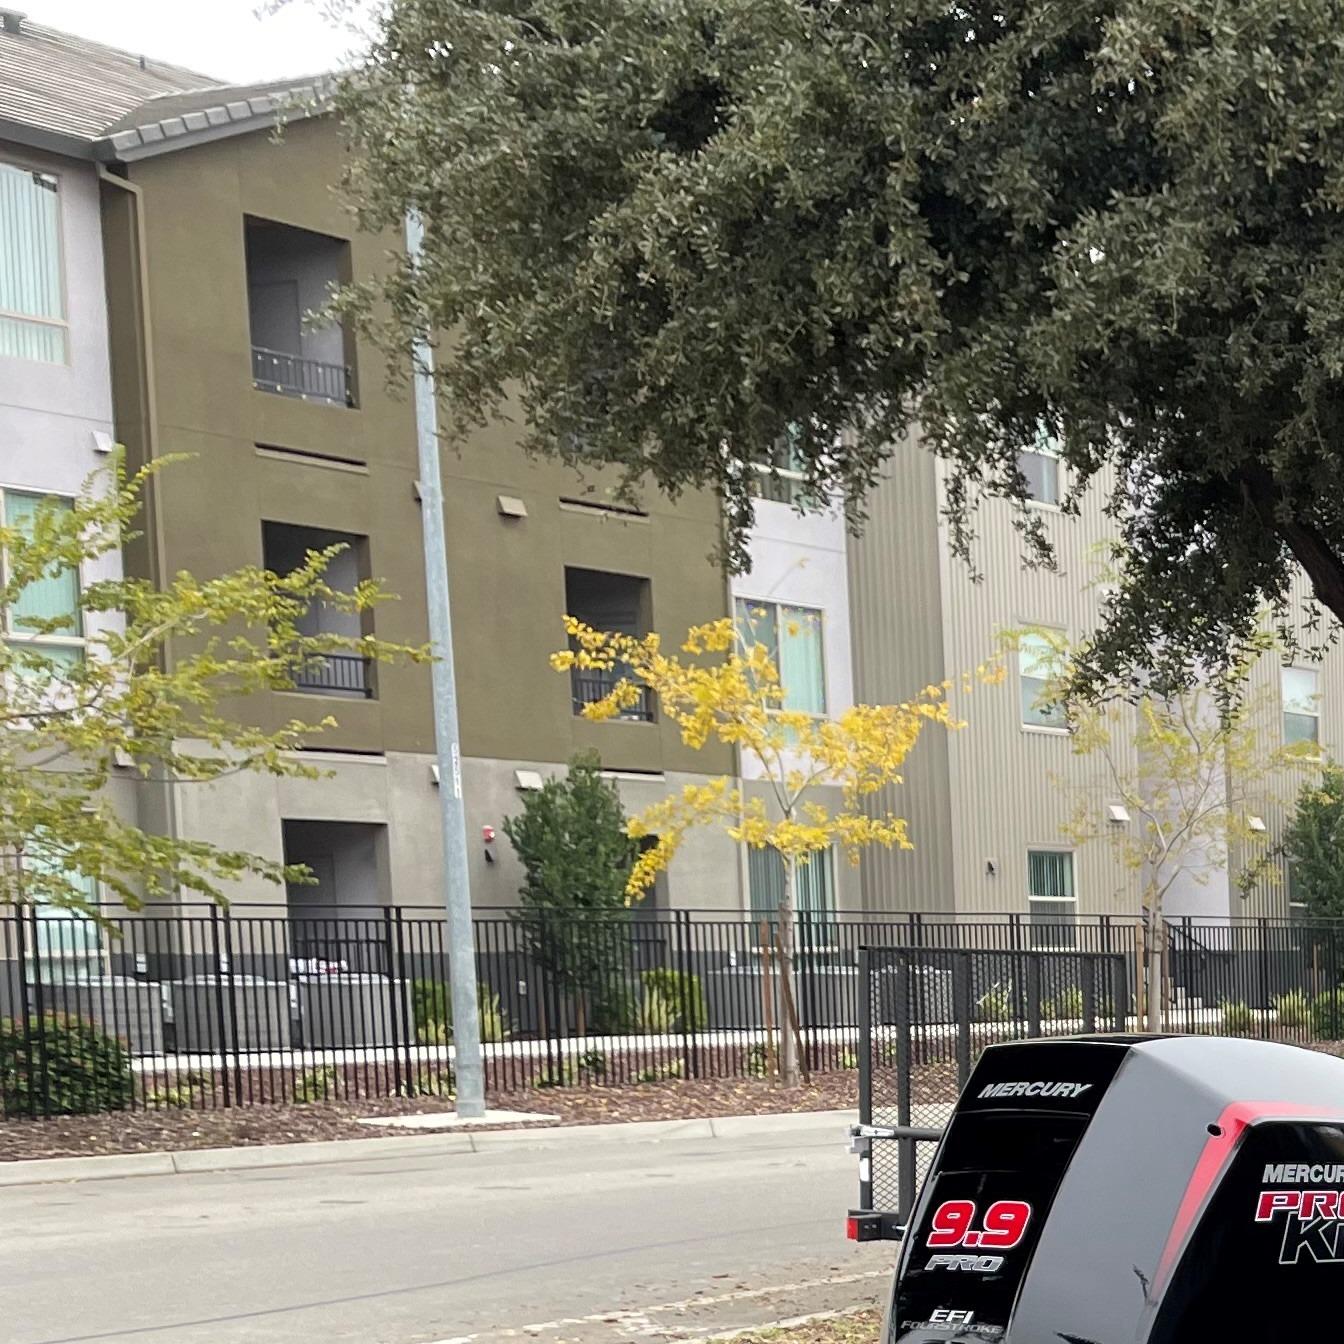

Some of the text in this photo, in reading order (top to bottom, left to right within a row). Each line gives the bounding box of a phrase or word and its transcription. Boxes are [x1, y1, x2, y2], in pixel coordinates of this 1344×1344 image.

[977, 1081, 1094, 1098] MERCURY
[926, 1200, 1032, 1249] 9.9
[924, 1254, 1005, 1272] PRO
[929, 1309, 975, 1324] EFI
[900, 1320, 1004, 1334] FOURSTROKE
